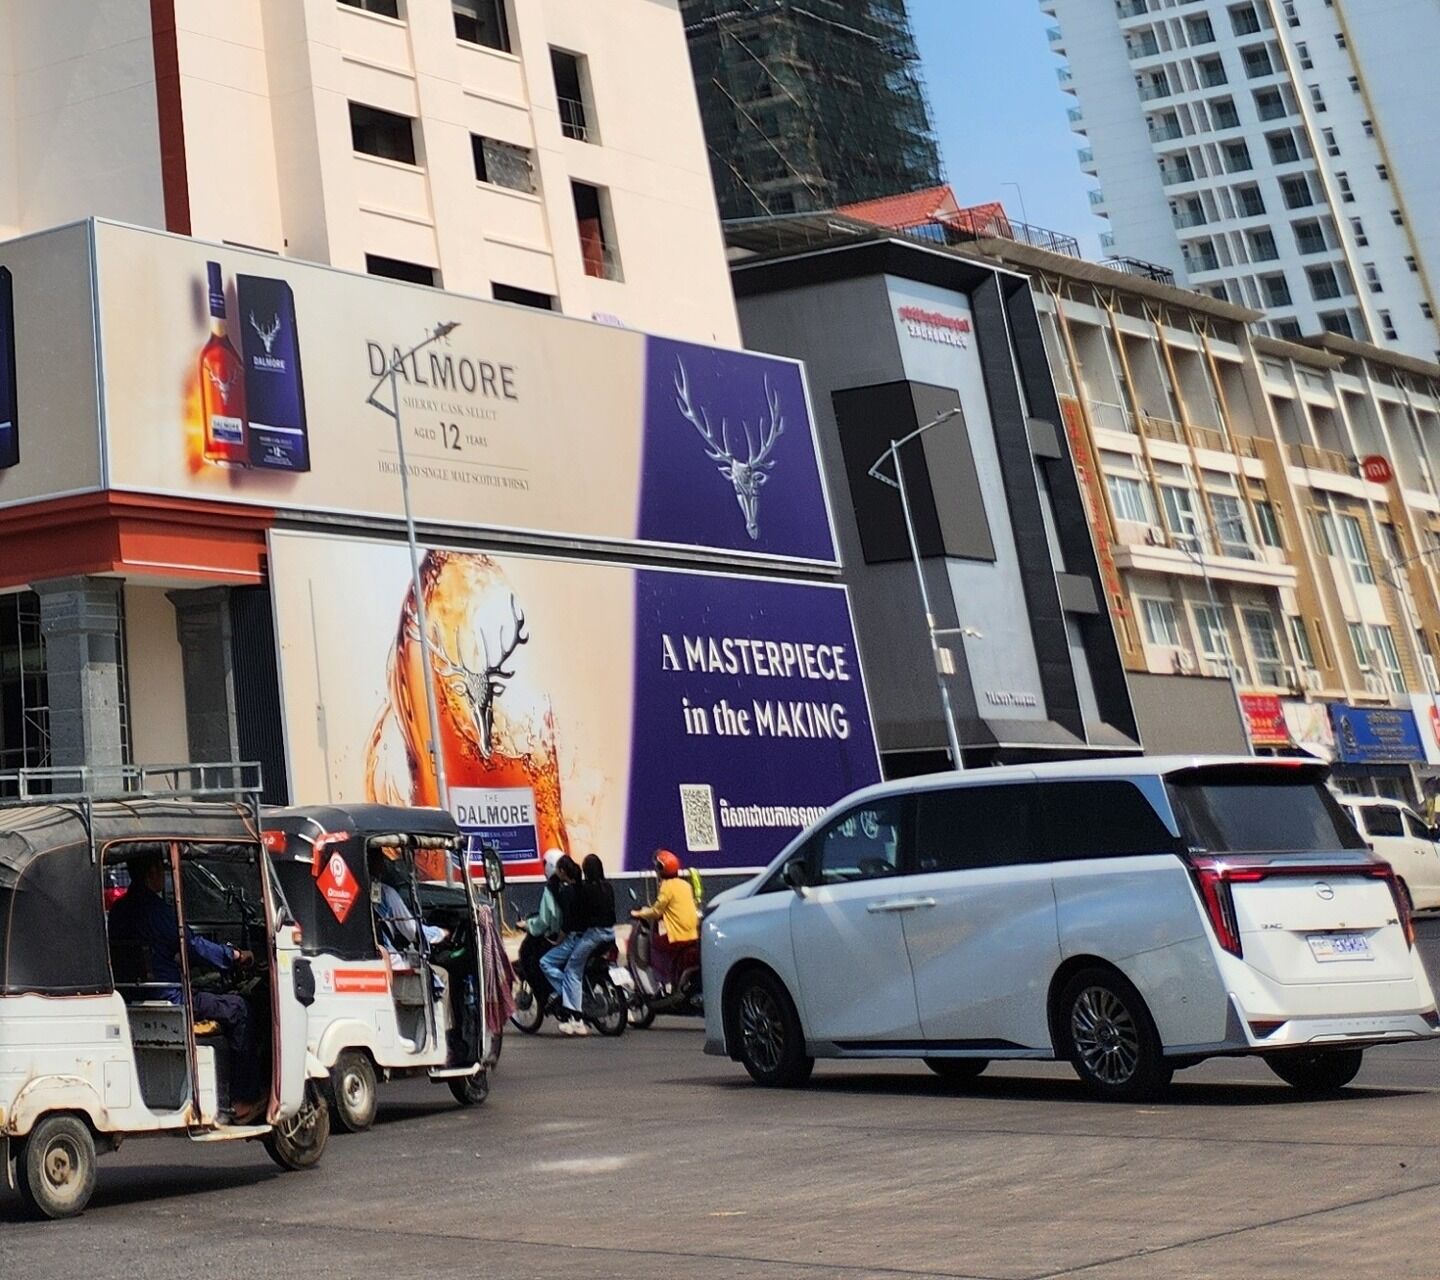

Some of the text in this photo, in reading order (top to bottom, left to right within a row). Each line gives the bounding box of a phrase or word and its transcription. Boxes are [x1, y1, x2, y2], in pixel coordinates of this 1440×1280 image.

[366, 339, 519, 401] DALMORE
[414, 421, 488, 451] AGED 12 YEARS
[662, 634, 851, 681] A MASTERPIECE
[682, 697, 849, 740] in the MAKING
[457, 804, 530, 825] DALMORE
